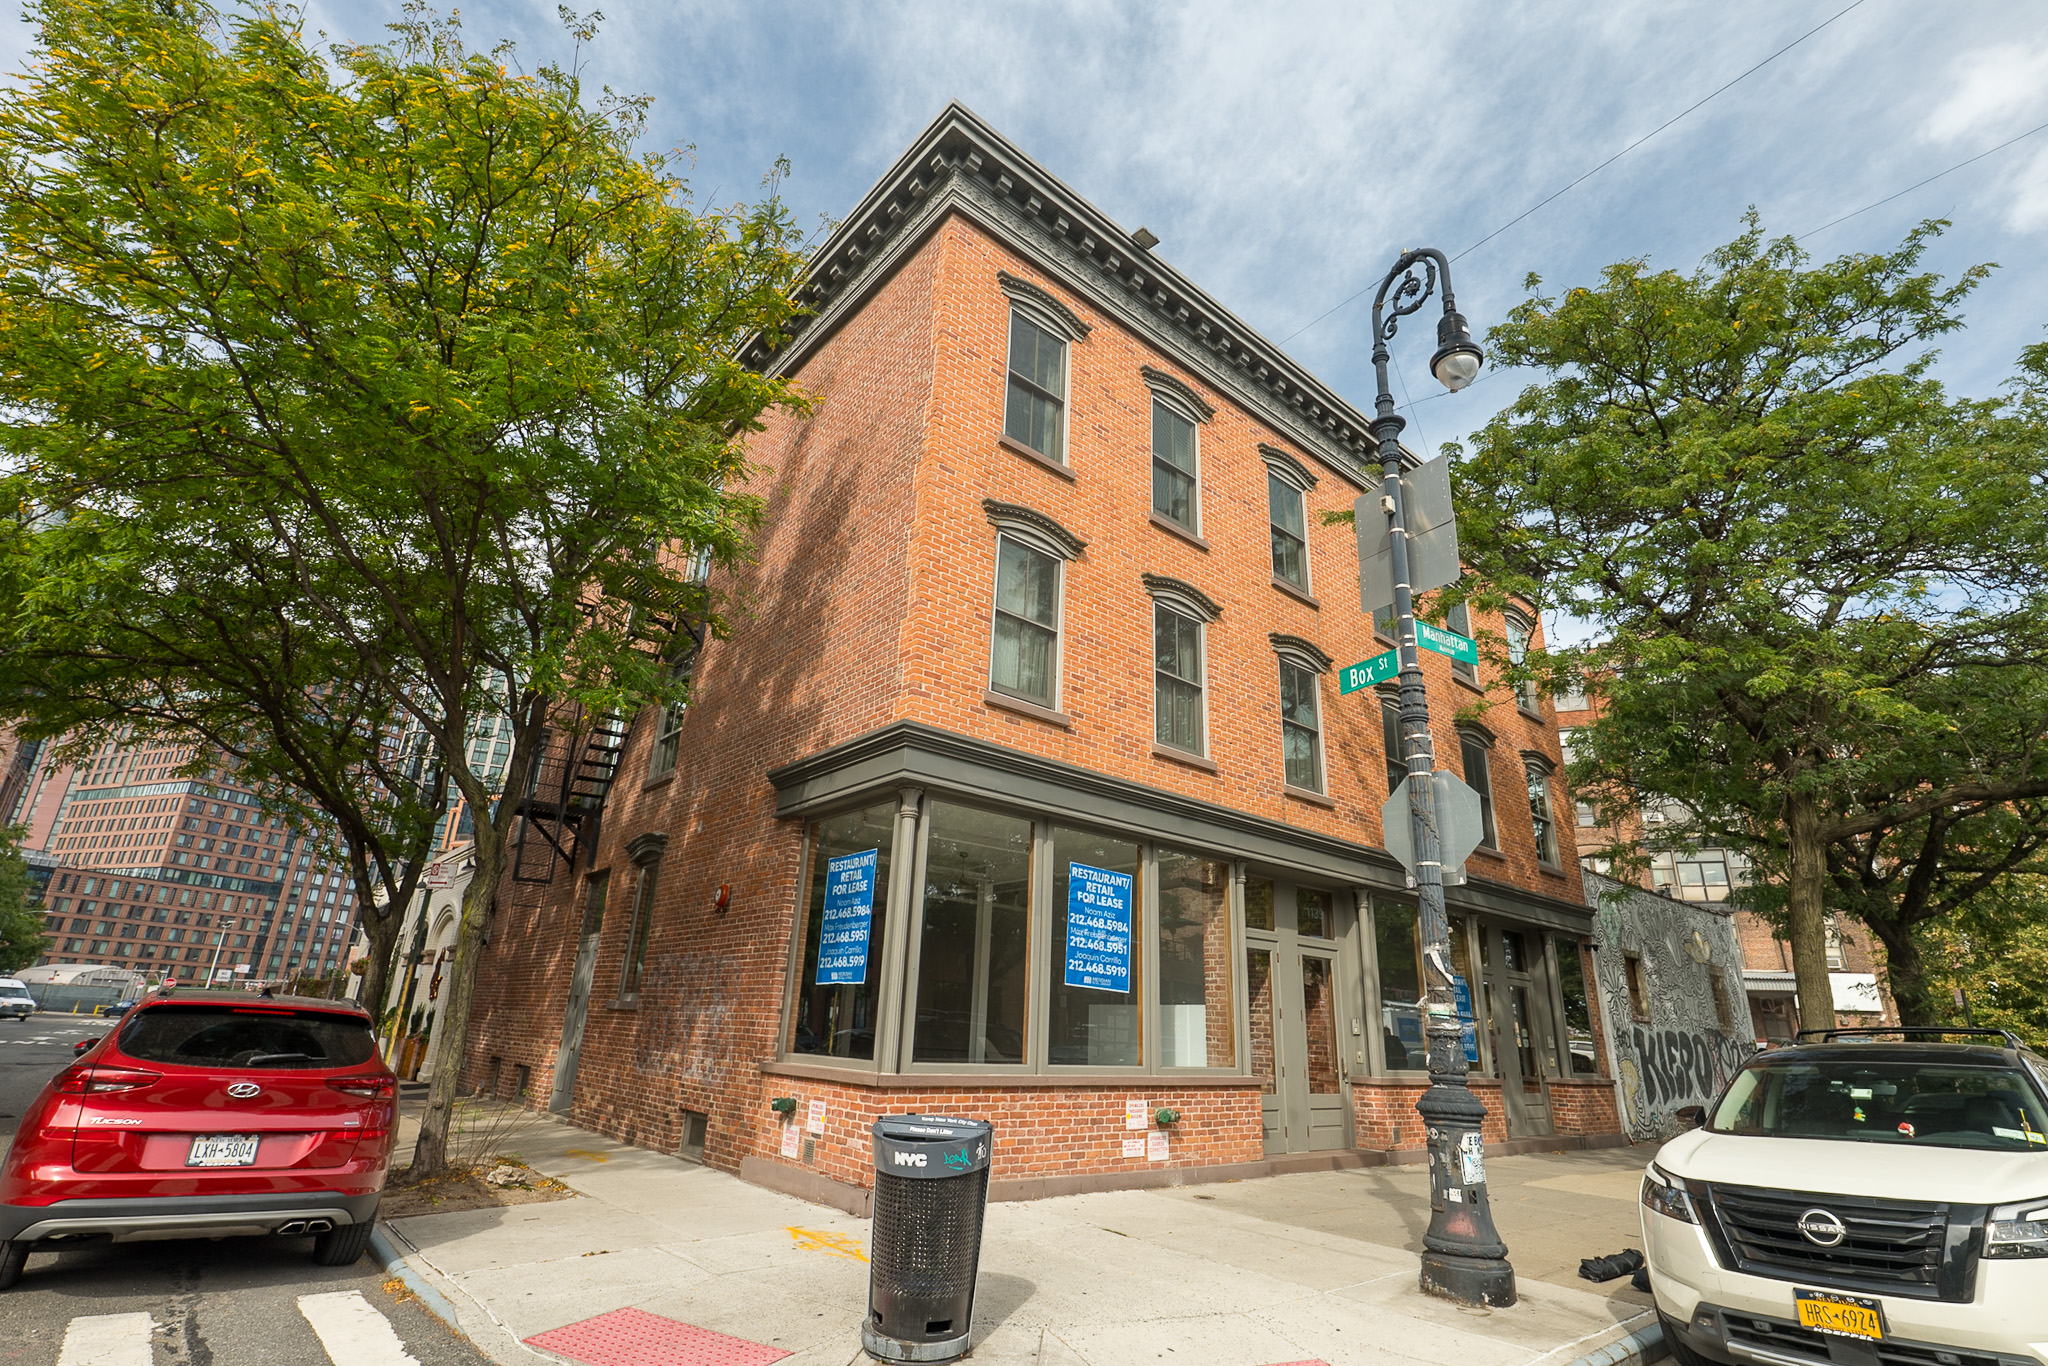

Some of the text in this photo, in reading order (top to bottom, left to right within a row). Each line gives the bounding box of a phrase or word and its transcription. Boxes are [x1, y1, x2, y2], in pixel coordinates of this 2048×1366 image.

[1422, 625, 1469, 652] Manhattan
[1350, 656, 1389, 688] Box St
[829, 854, 875, 873] RESTAURANT/
[840, 869, 863, 883] RETAIL
[1071, 866, 1131, 890] RESTAURANT/
[832, 880, 868, 896] FOR LEASE
[1086, 881, 1115, 897] RETAIL
[1077, 891, 1124, 910] FOR LEASE
[824, 904, 870, 921] 212.468.5984
[1084, 906, 1103, 917] Noam
[1069, 913, 1129, 934] 212.468.5984
[822, 930, 868, 945] 212.468.5951
[1069, 936, 1128, 956] 212.468.5951
[819, 955, 865, 969] 212.468.5919
[1074, 951, 1100, 964] Joaquin
[1068, 959, 1127, 978] 212.468.5919
[926, 1127, 940, 1135] Don't
[894, 1151, 928, 1168] NYC
[1797, 1221, 1847, 1235] NISSAN
[1813, 1327, 1874, 1341] KOEPPEL
